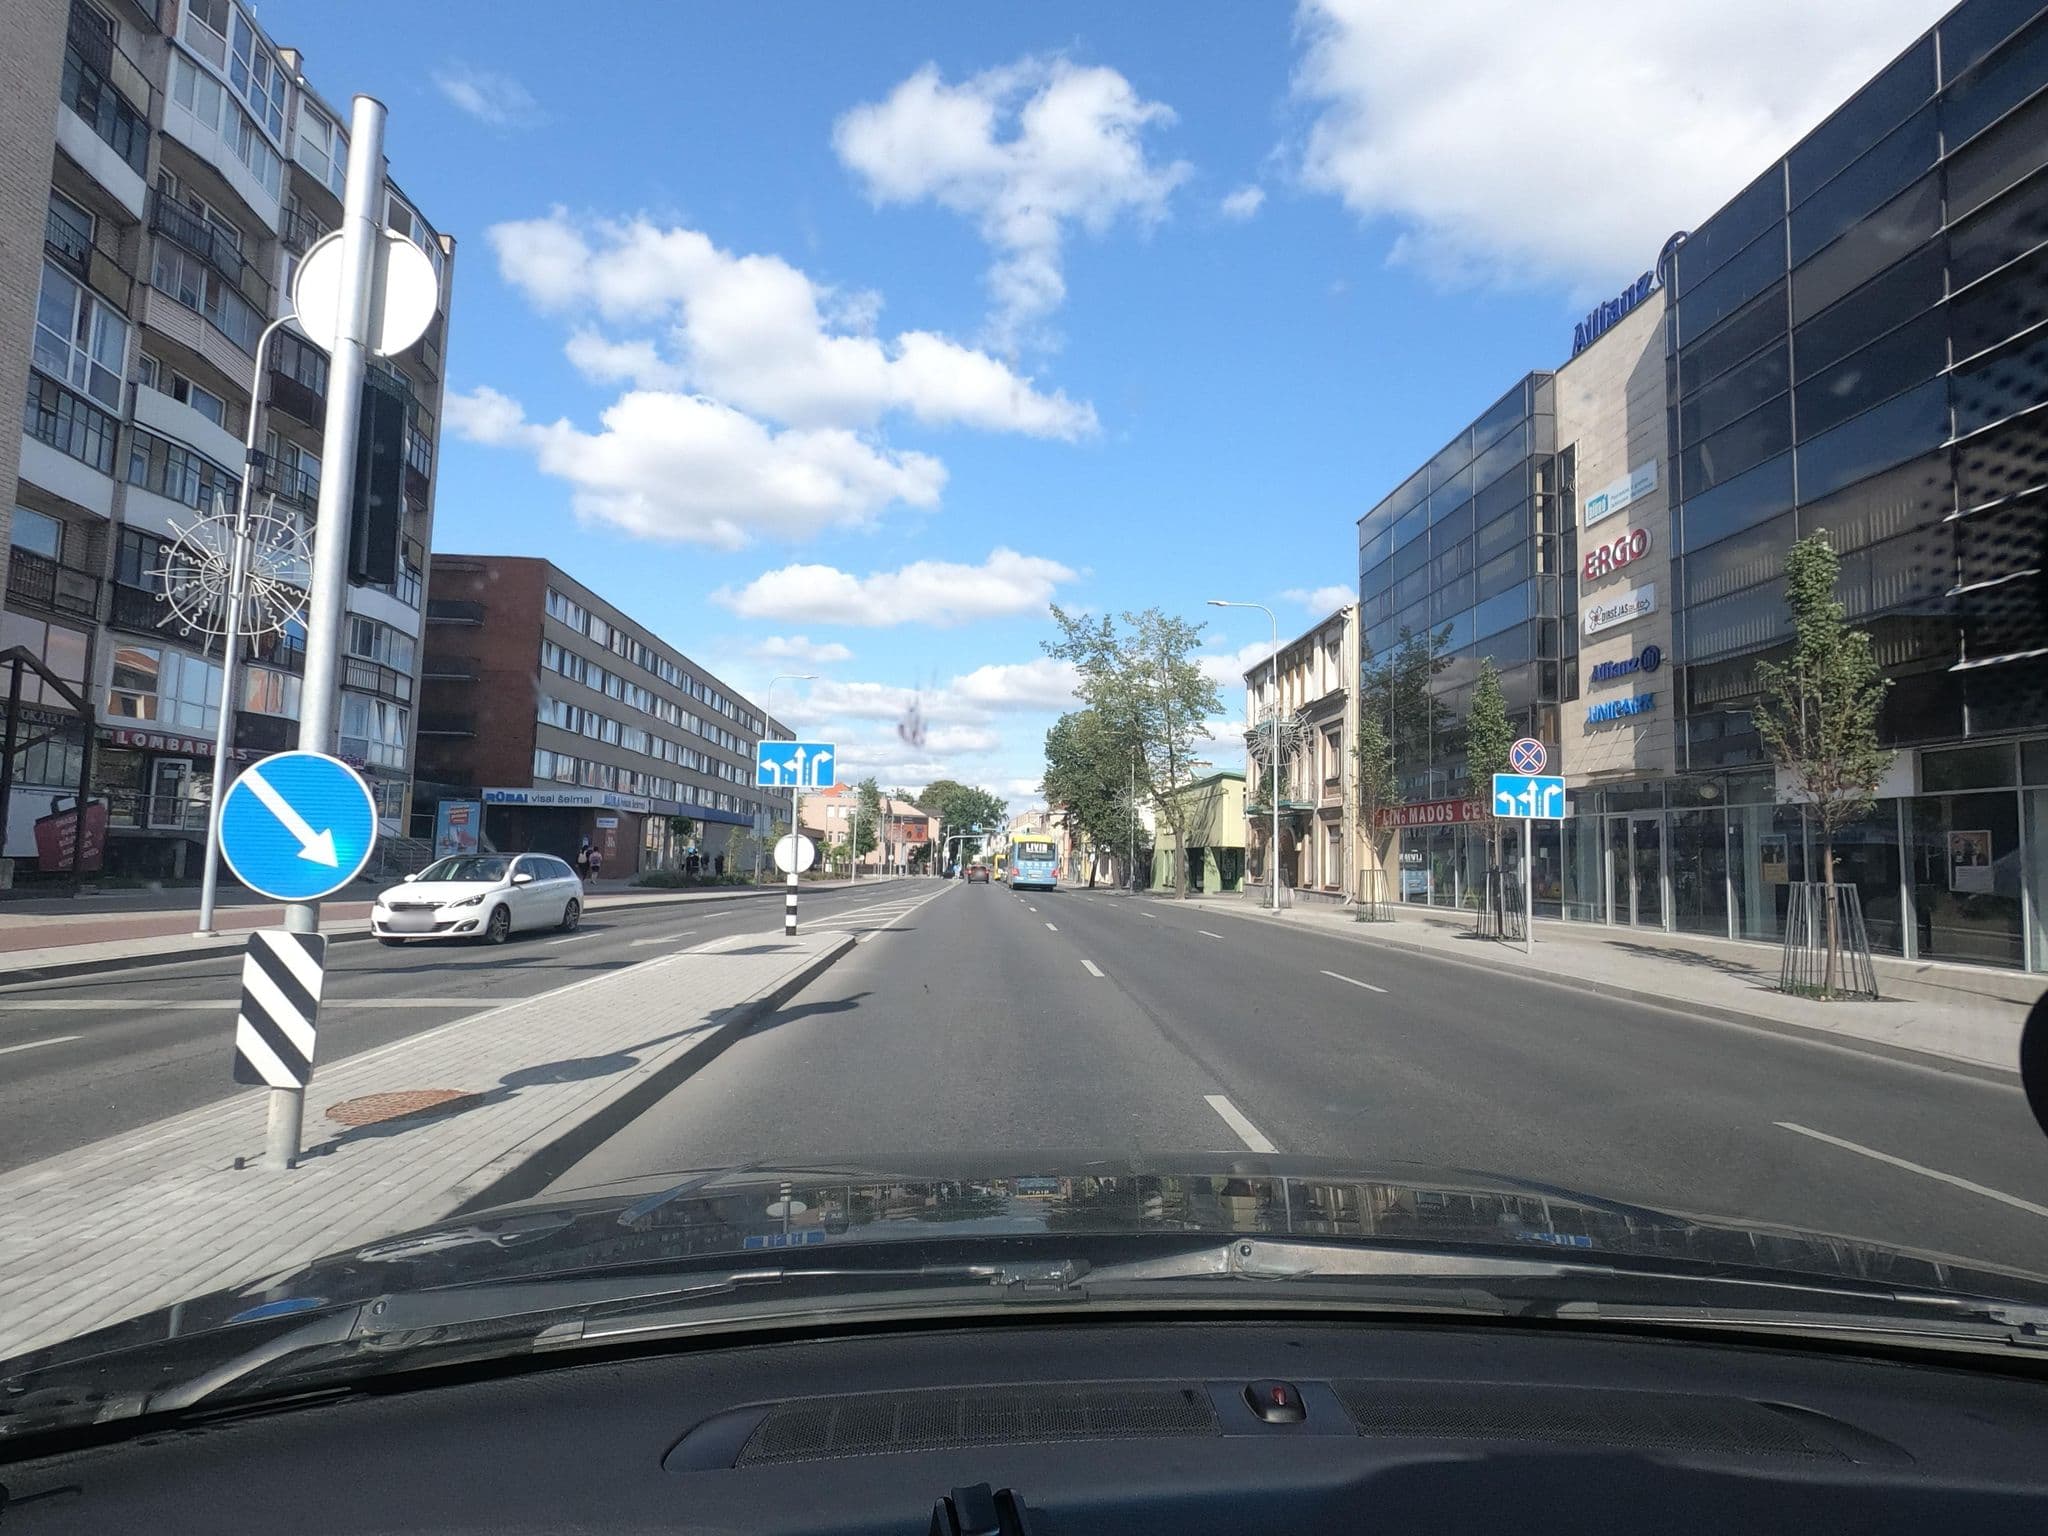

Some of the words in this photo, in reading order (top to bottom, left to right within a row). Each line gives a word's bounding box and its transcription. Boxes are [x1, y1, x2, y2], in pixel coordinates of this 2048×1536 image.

[1572, 271, 1655, 357] Allianz
[1584, 529, 1648, 580] ERGO
[1590, 657, 1640, 683] Allianz
[1409, 804, 1454, 824] MADOS
